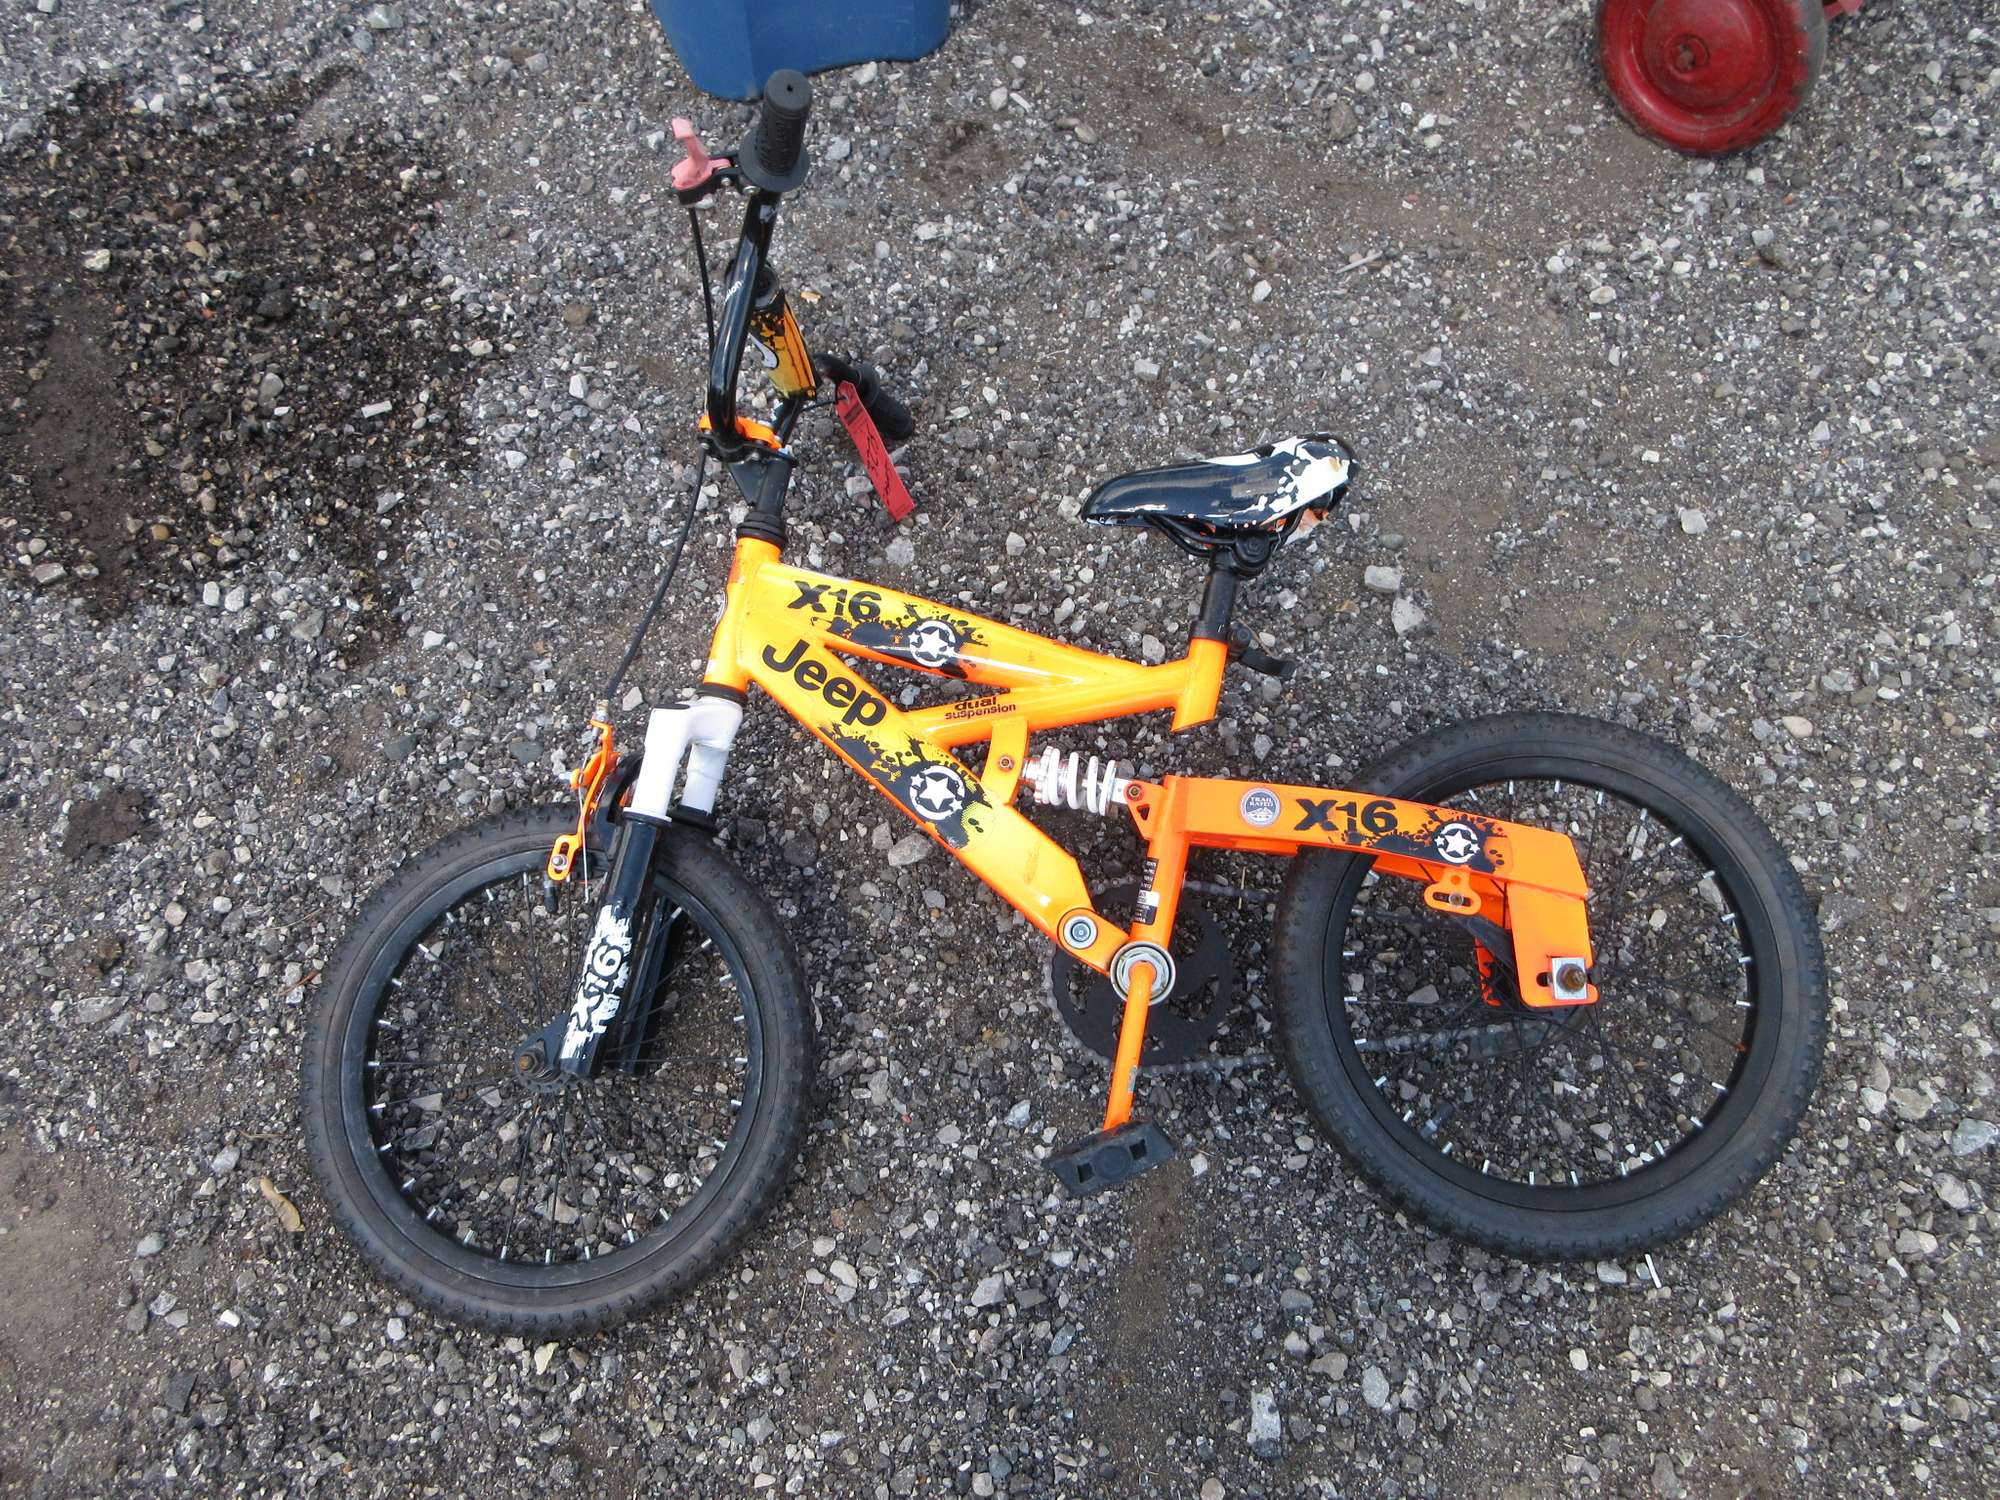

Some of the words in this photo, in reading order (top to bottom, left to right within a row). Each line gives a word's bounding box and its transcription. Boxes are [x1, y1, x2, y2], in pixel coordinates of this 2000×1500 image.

[787, 580, 882, 620] X16
[762, 638, 887, 727] Jeep
[945, 704, 1016, 719] suspension
[954, 696, 997, 711] dual
[1293, 798, 1398, 834] X16
